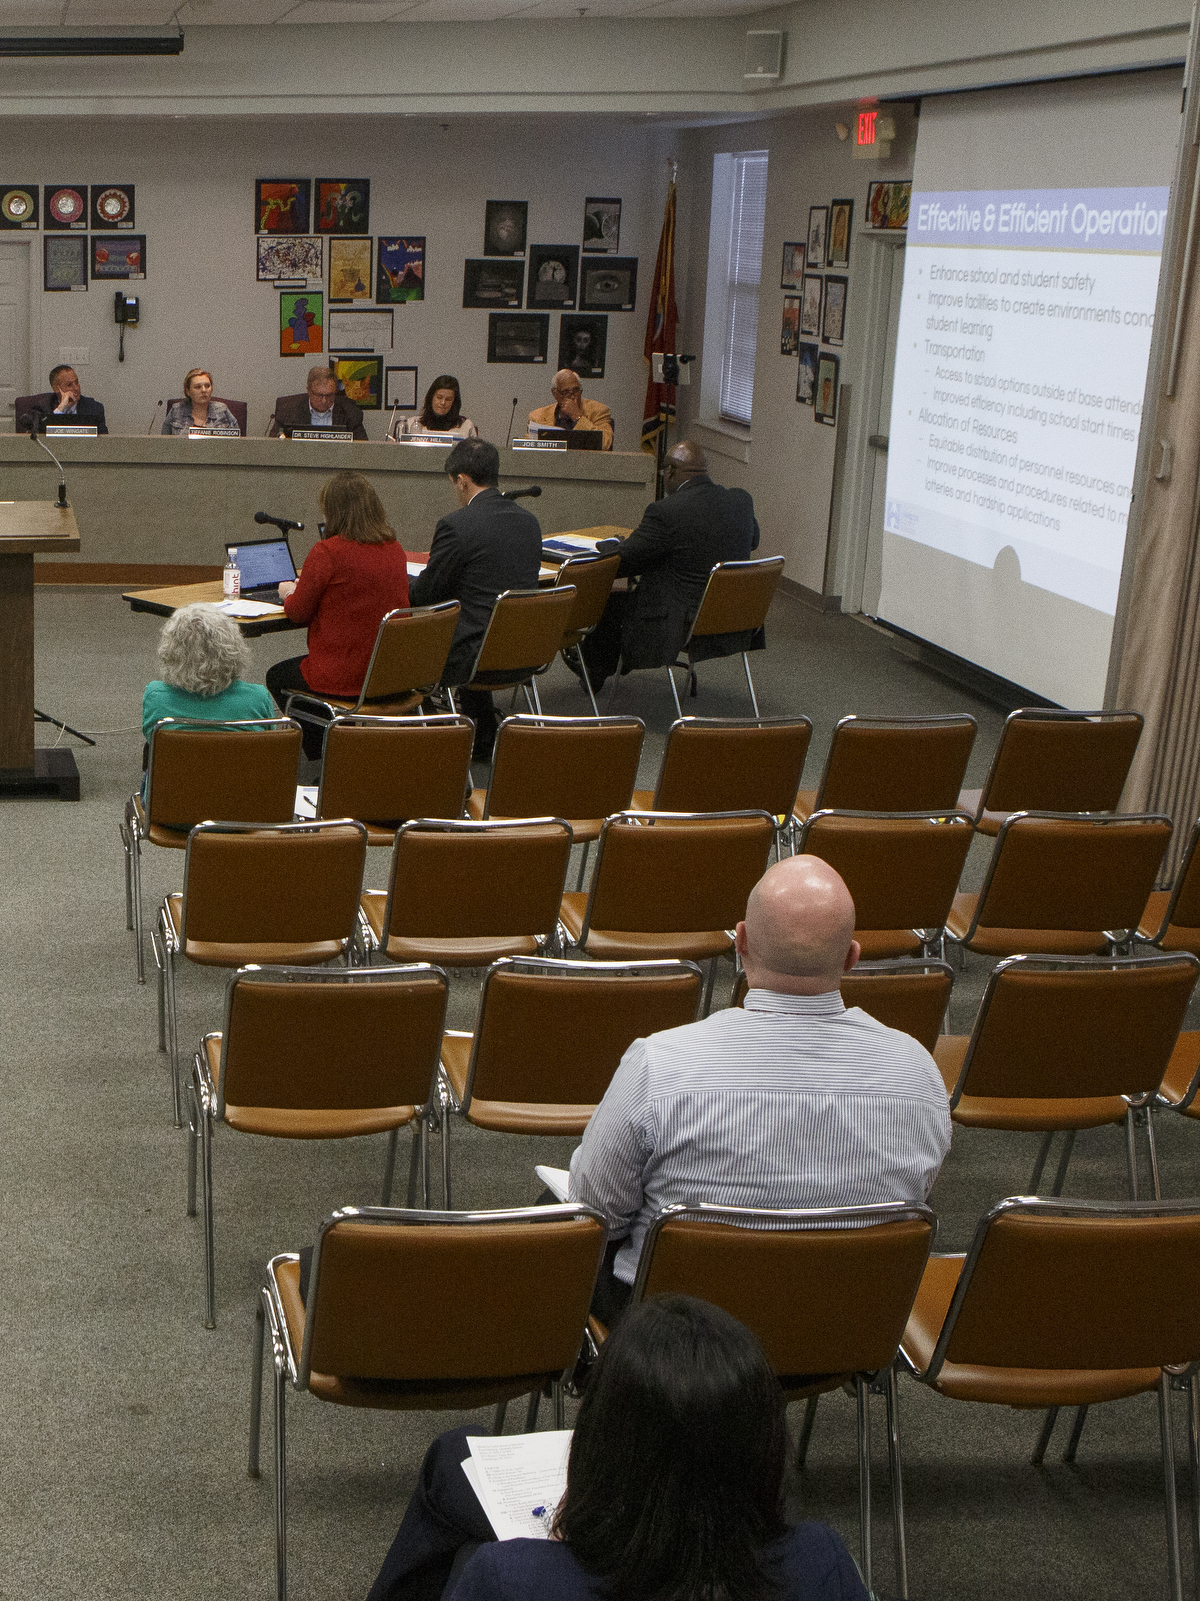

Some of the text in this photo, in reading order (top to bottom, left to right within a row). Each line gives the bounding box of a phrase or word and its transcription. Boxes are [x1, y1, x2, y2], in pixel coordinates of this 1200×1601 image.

[917, 203, 981, 231] Effective
[983, 204, 995, 232] &
[998, 202, 1068, 233] Efficient
[930, 265, 1096, 295] Enhance school and student safety
[928, 290, 963, 309] Improve
[1001, 296, 1011, 312] to
[1013, 299, 1045, 316] create
[1047, 302, 1120, 324] environments
[926, 315, 993, 341] student learning
[924, 339, 985, 361] Transportation
[935, 365, 962, 382] Access
[965, 370, 972, 384] to
[974, 373, 997, 388] school
[998, 376, 1030, 394] options
[1032, 383, 1065, 401] outside
[1067, 387, 1077, 403] of
[1079, 388, 1102, 408] base
[918, 407, 1017, 444] Allocation of Resources
[933, 387, 970, 406] Improved
[1007, 401, 1047, 426] including
[1049, 411, 1079, 429] school
[1081, 418, 1104, 434] start
[1107, 421, 1135, 442] times
[929, 433, 964, 454] Equitable
[966, 443, 1007, 465] distribution
[1009, 454, 1018, 467] of
[1019, 459, 1064, 480] personnel
[1065, 470, 1114, 495] resources
[927, 457, 956, 476] Improve
[998, 477, 1015, 491] and
[1016, 482, 1067, 507] procedures
[1069, 496, 1105, 518] related
[1107, 505, 1116, 522] to
[955, 489, 971, 502] and
[973, 490, 1005, 516] hardship
[1007, 504, 1060, 531] applications
